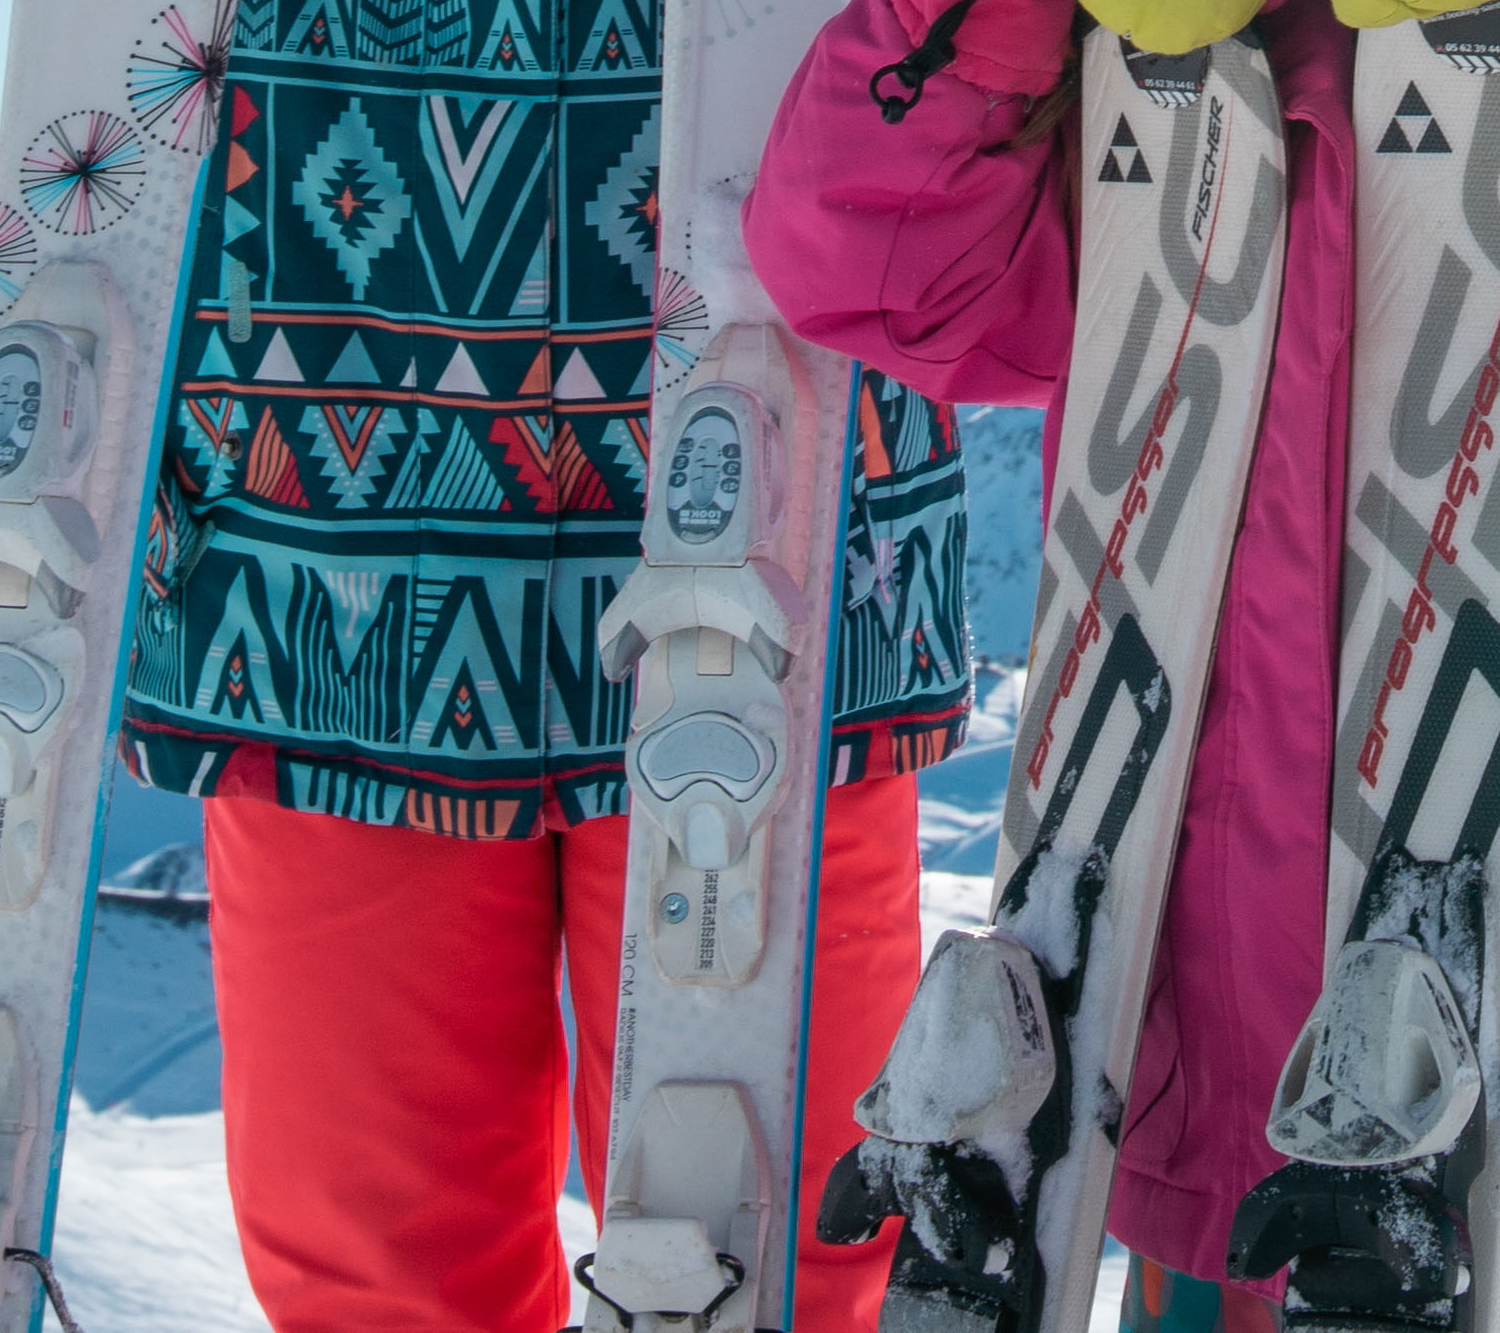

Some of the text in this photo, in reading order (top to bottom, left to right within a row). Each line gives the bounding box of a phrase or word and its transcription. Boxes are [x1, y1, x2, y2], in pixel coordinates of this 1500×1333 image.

[1445, 43, 1458, 52] 05
[1460, 43, 1473, 52] 62
[1474, 44, 1487, 53] 39
[1488, 44, 1500, 53] 44
[1190, 93, 1225, 243] FISCHER
[690, 509, 721, 518] LOOK
[1026, 370, 1180, 790] progressor
[704, 874, 719, 883] 262
[703, 884, 718, 893] 255
[702, 906, 716, 915] 241
[701, 916, 716, 926] 234
[701, 927, 715, 936] 227
[700, 937, 715, 947] 220
[620, 933, 638, 997] 120 CM
